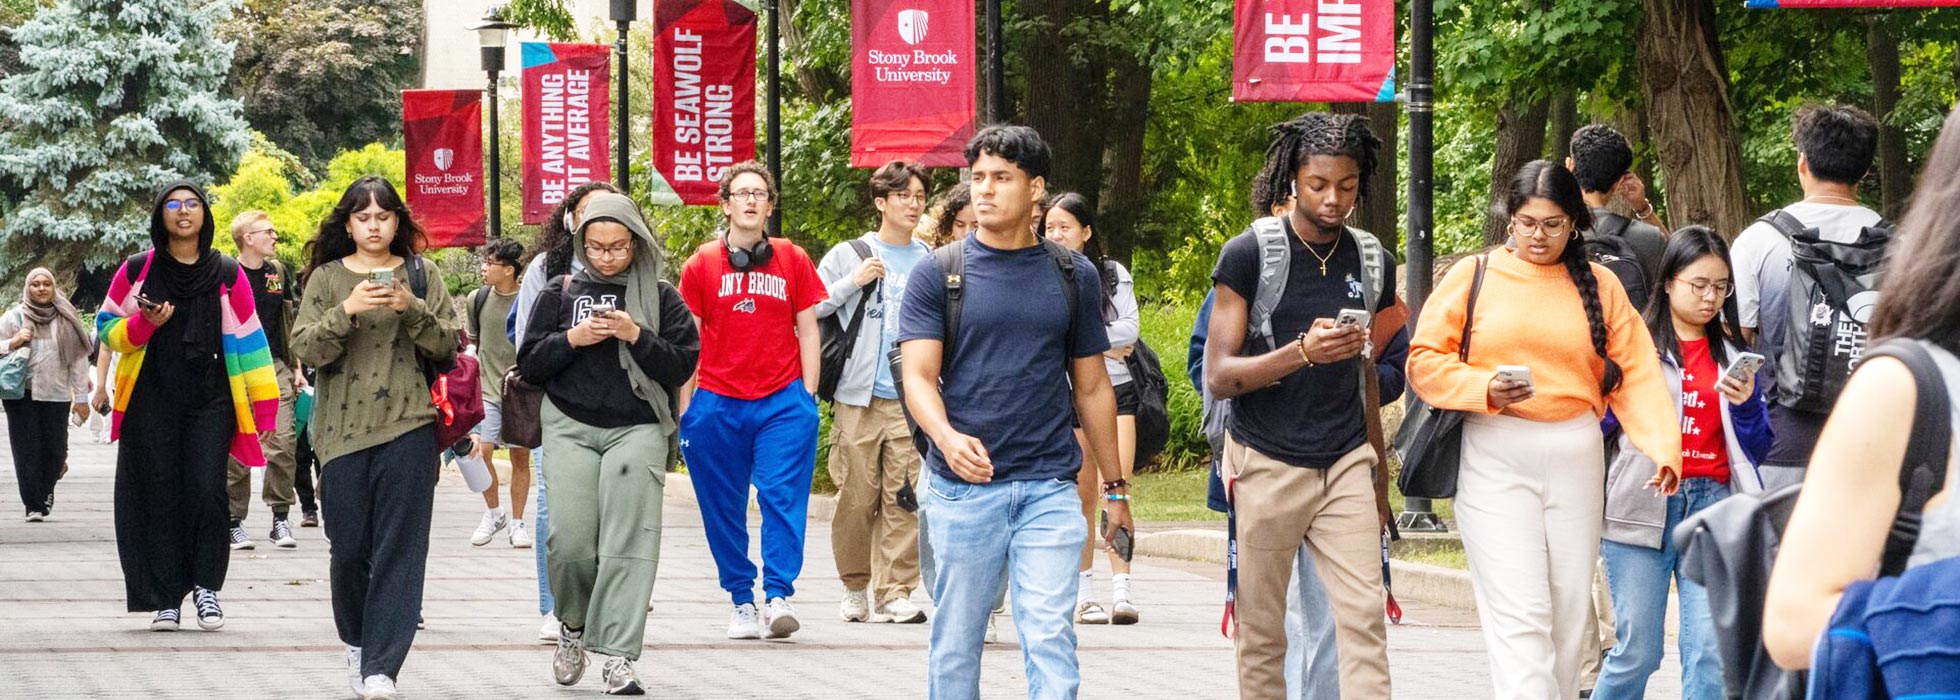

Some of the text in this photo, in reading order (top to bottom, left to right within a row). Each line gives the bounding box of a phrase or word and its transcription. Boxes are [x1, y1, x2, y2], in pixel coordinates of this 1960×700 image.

[868, 49, 958, 67] Stony Brook
[1264, 12, 1310, 63] BE
[875, 66, 951, 85] University
[673, 27, 703, 182] BE SEAWOLF
[541, 73, 565, 205] BE ANYTHING
[567, 68, 591, 196] UT AVERAGE
[704, 84, 734, 183] STRONG
[414, 172, 473, 185] Stony Brook
[419, 184, 469, 195] University
[747, 271, 787, 302] BROOK
[1834, 321, 1854, 356] THE
[1846, 322, 1868, 375] ORTH
